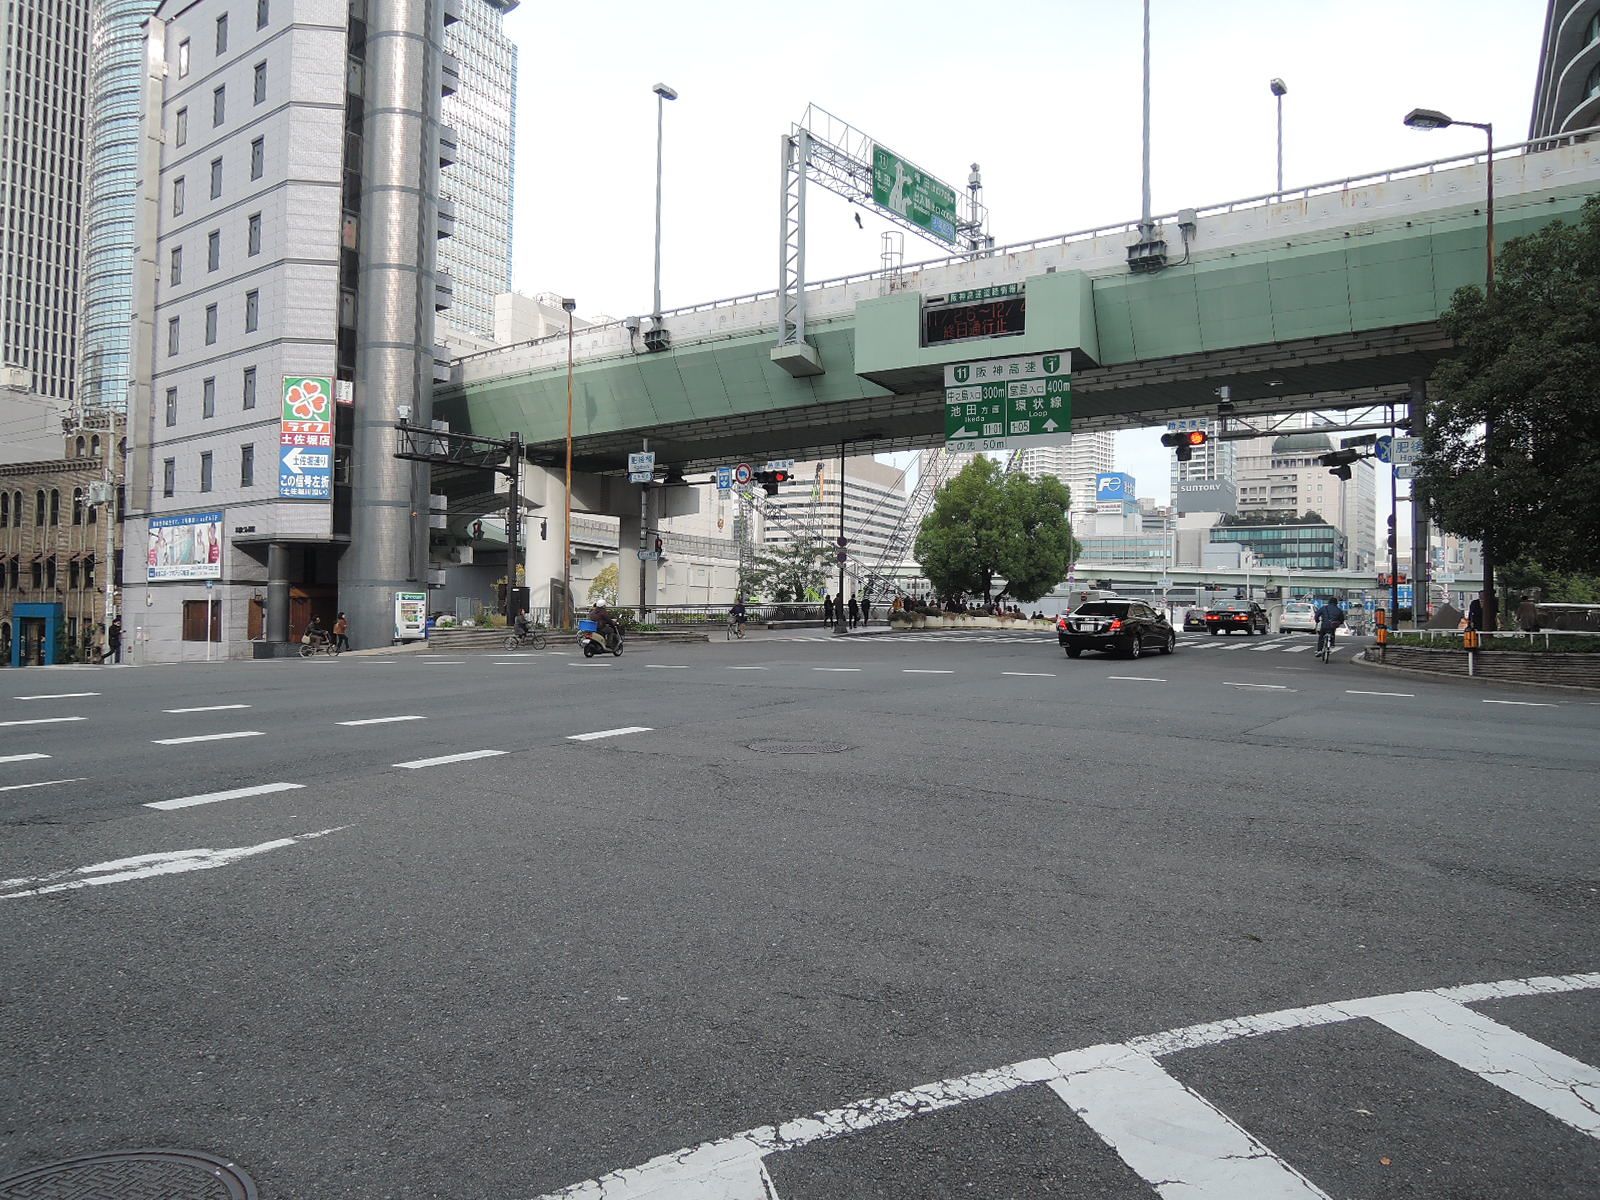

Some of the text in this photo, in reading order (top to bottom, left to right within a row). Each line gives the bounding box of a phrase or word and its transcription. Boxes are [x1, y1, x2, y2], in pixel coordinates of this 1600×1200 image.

[956, 368, 967, 379] 11
[975, 361, 1037, 378] 阪神高速
[983, 386, 1005, 399] 300m
[1009, 380, 1070, 397] 堂島入口 400m
[1015, 396, 1063, 412] 環状線
[950, 405, 1000, 417] 池田方面
[1029, 410, 1048, 418] Loop
[287, 422, 324, 432] ライフ
[281, 434, 330, 446] 土佐堀店
[947, 440, 1004, 452] この先 50m
[293, 455, 326, 466] 土佐堀通り
[280, 474, 329, 488] この信号左折
[1180, 483, 1222, 493] SUNTORY
